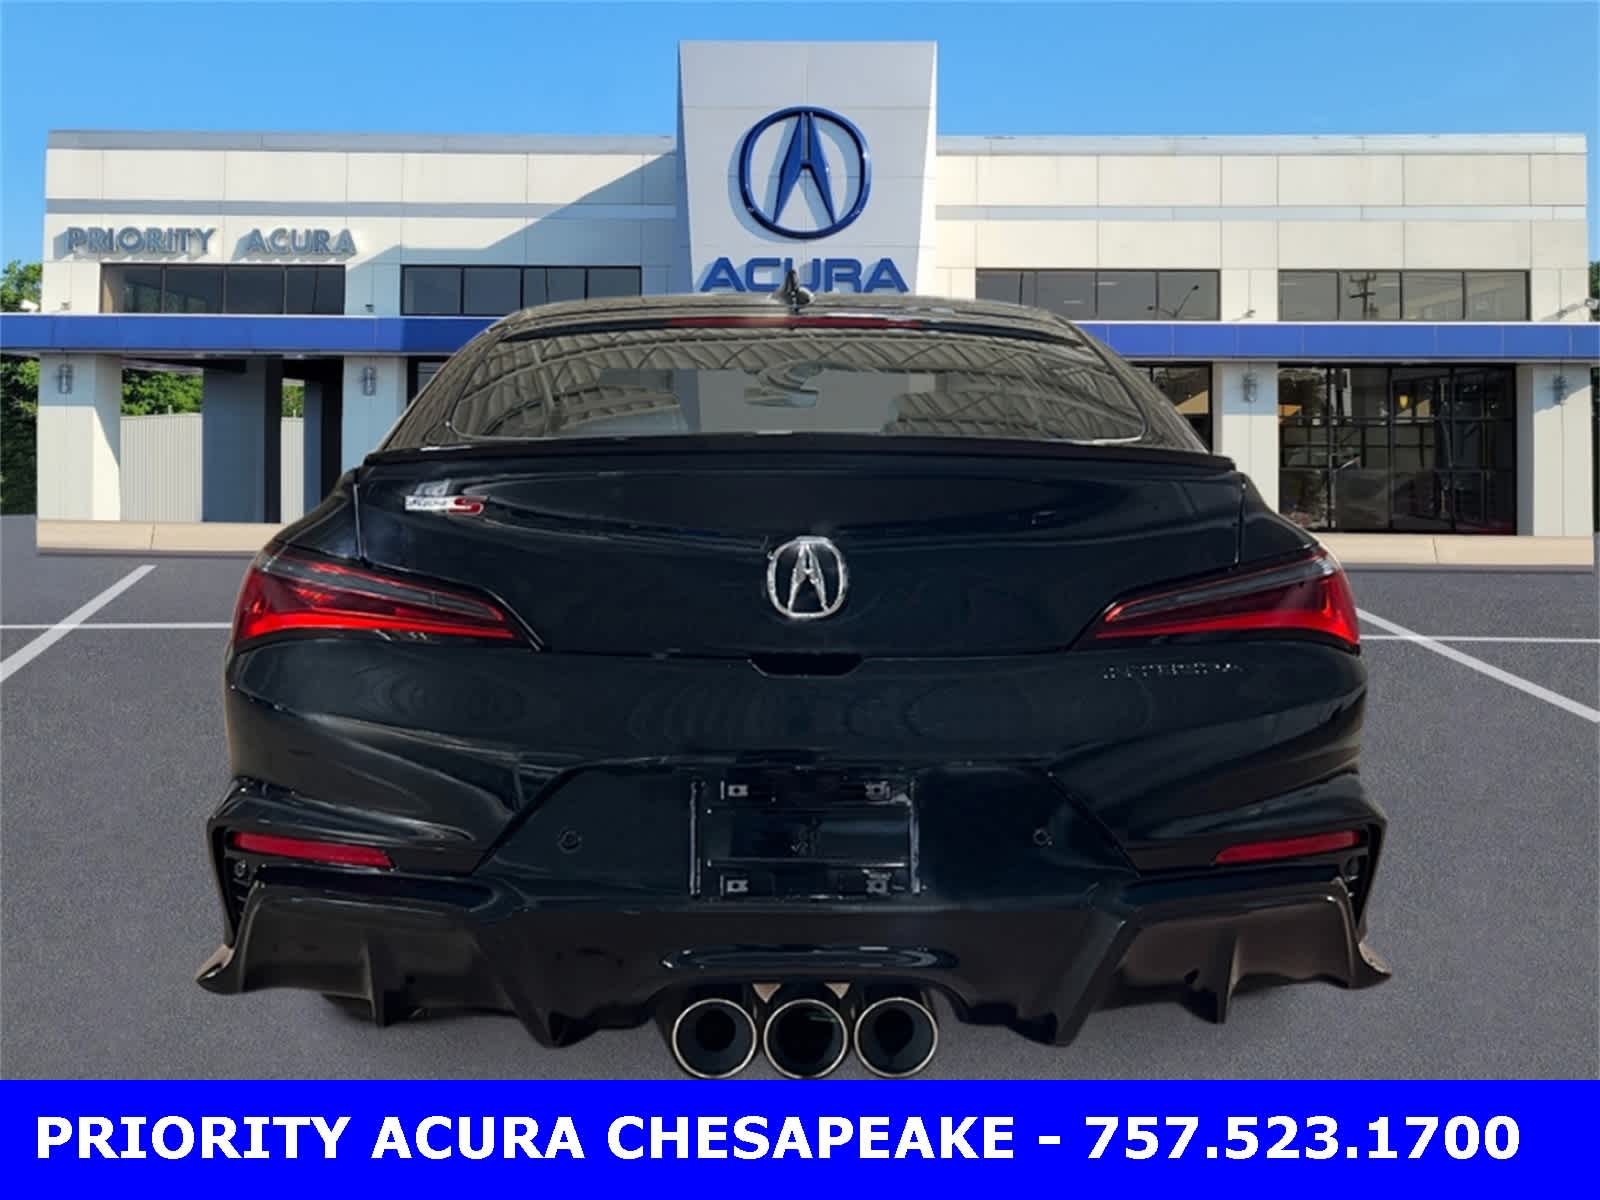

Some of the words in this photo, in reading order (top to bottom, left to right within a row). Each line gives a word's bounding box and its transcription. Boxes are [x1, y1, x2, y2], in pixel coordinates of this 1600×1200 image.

[65, 226, 216, 253] PRIORITY
[246, 227, 357, 256] ACURA
[700, 257, 909, 293] ACURA
